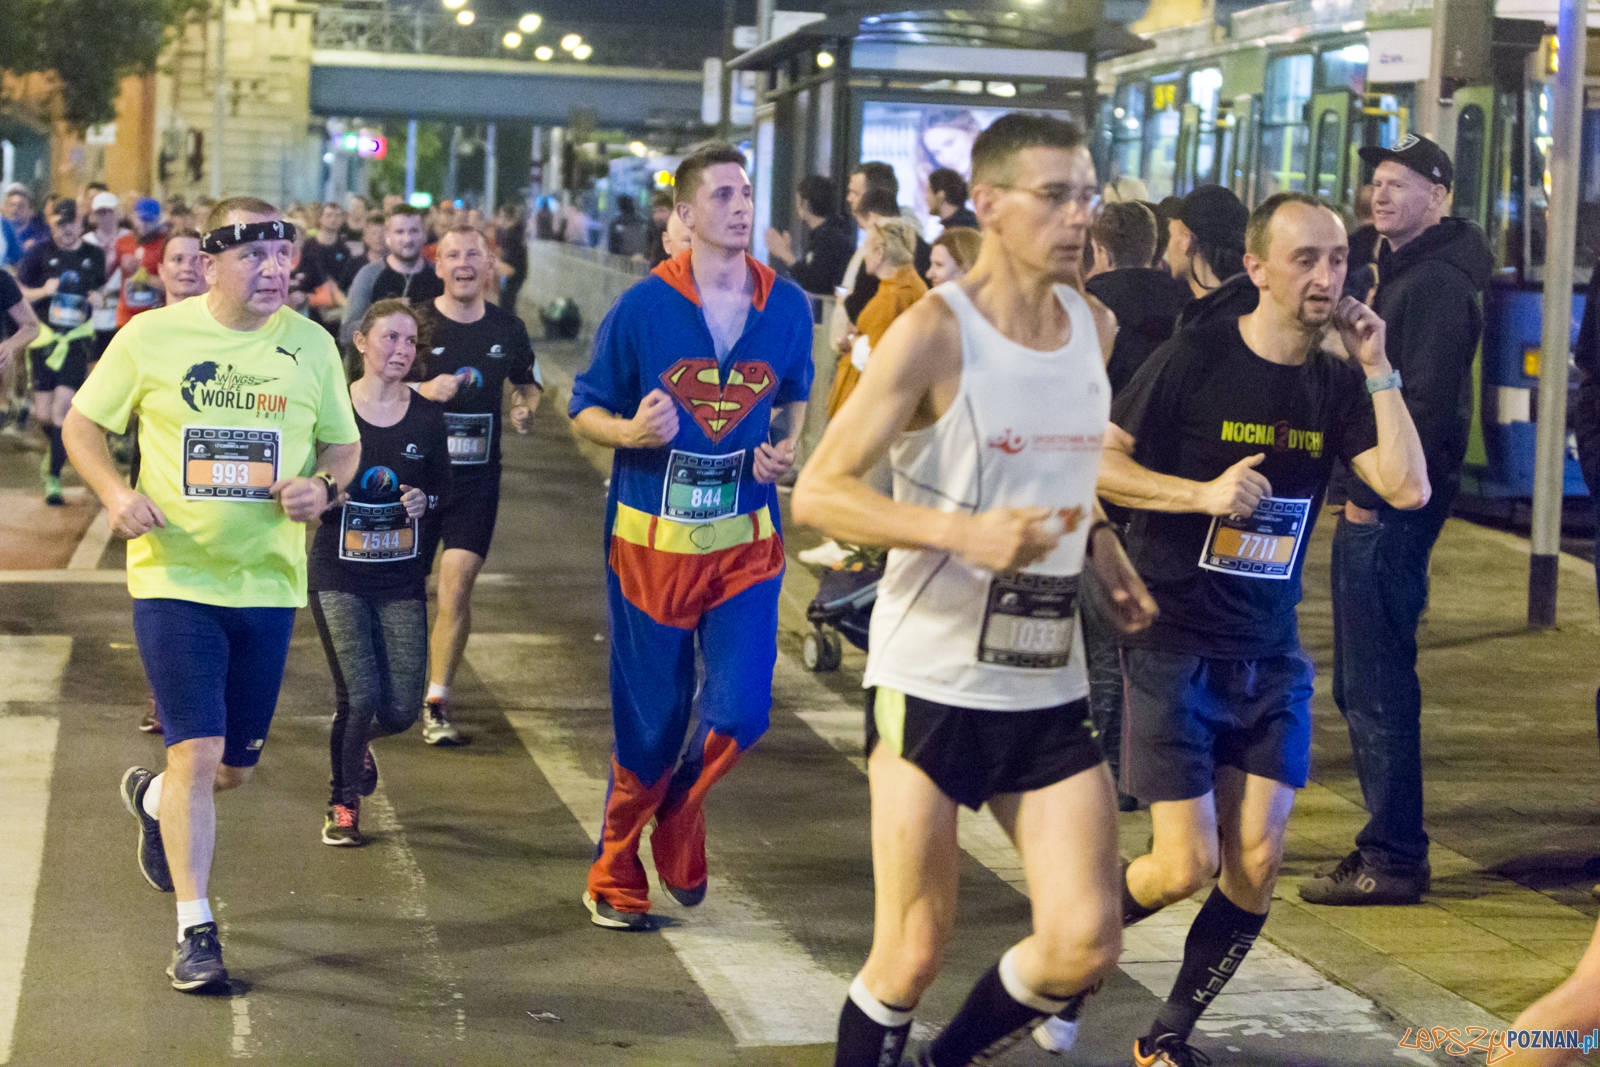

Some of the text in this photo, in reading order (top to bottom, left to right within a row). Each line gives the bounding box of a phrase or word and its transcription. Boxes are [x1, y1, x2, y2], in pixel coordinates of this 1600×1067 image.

[201, 389, 287, 413] WORLD RUN
[1221, 420, 1275, 446] NOCNA
[211, 462, 249, 485] 993
[690, 487, 722, 508] 844
[361, 532, 399, 549] 7544
[1237, 534, 1278, 561] 7711
